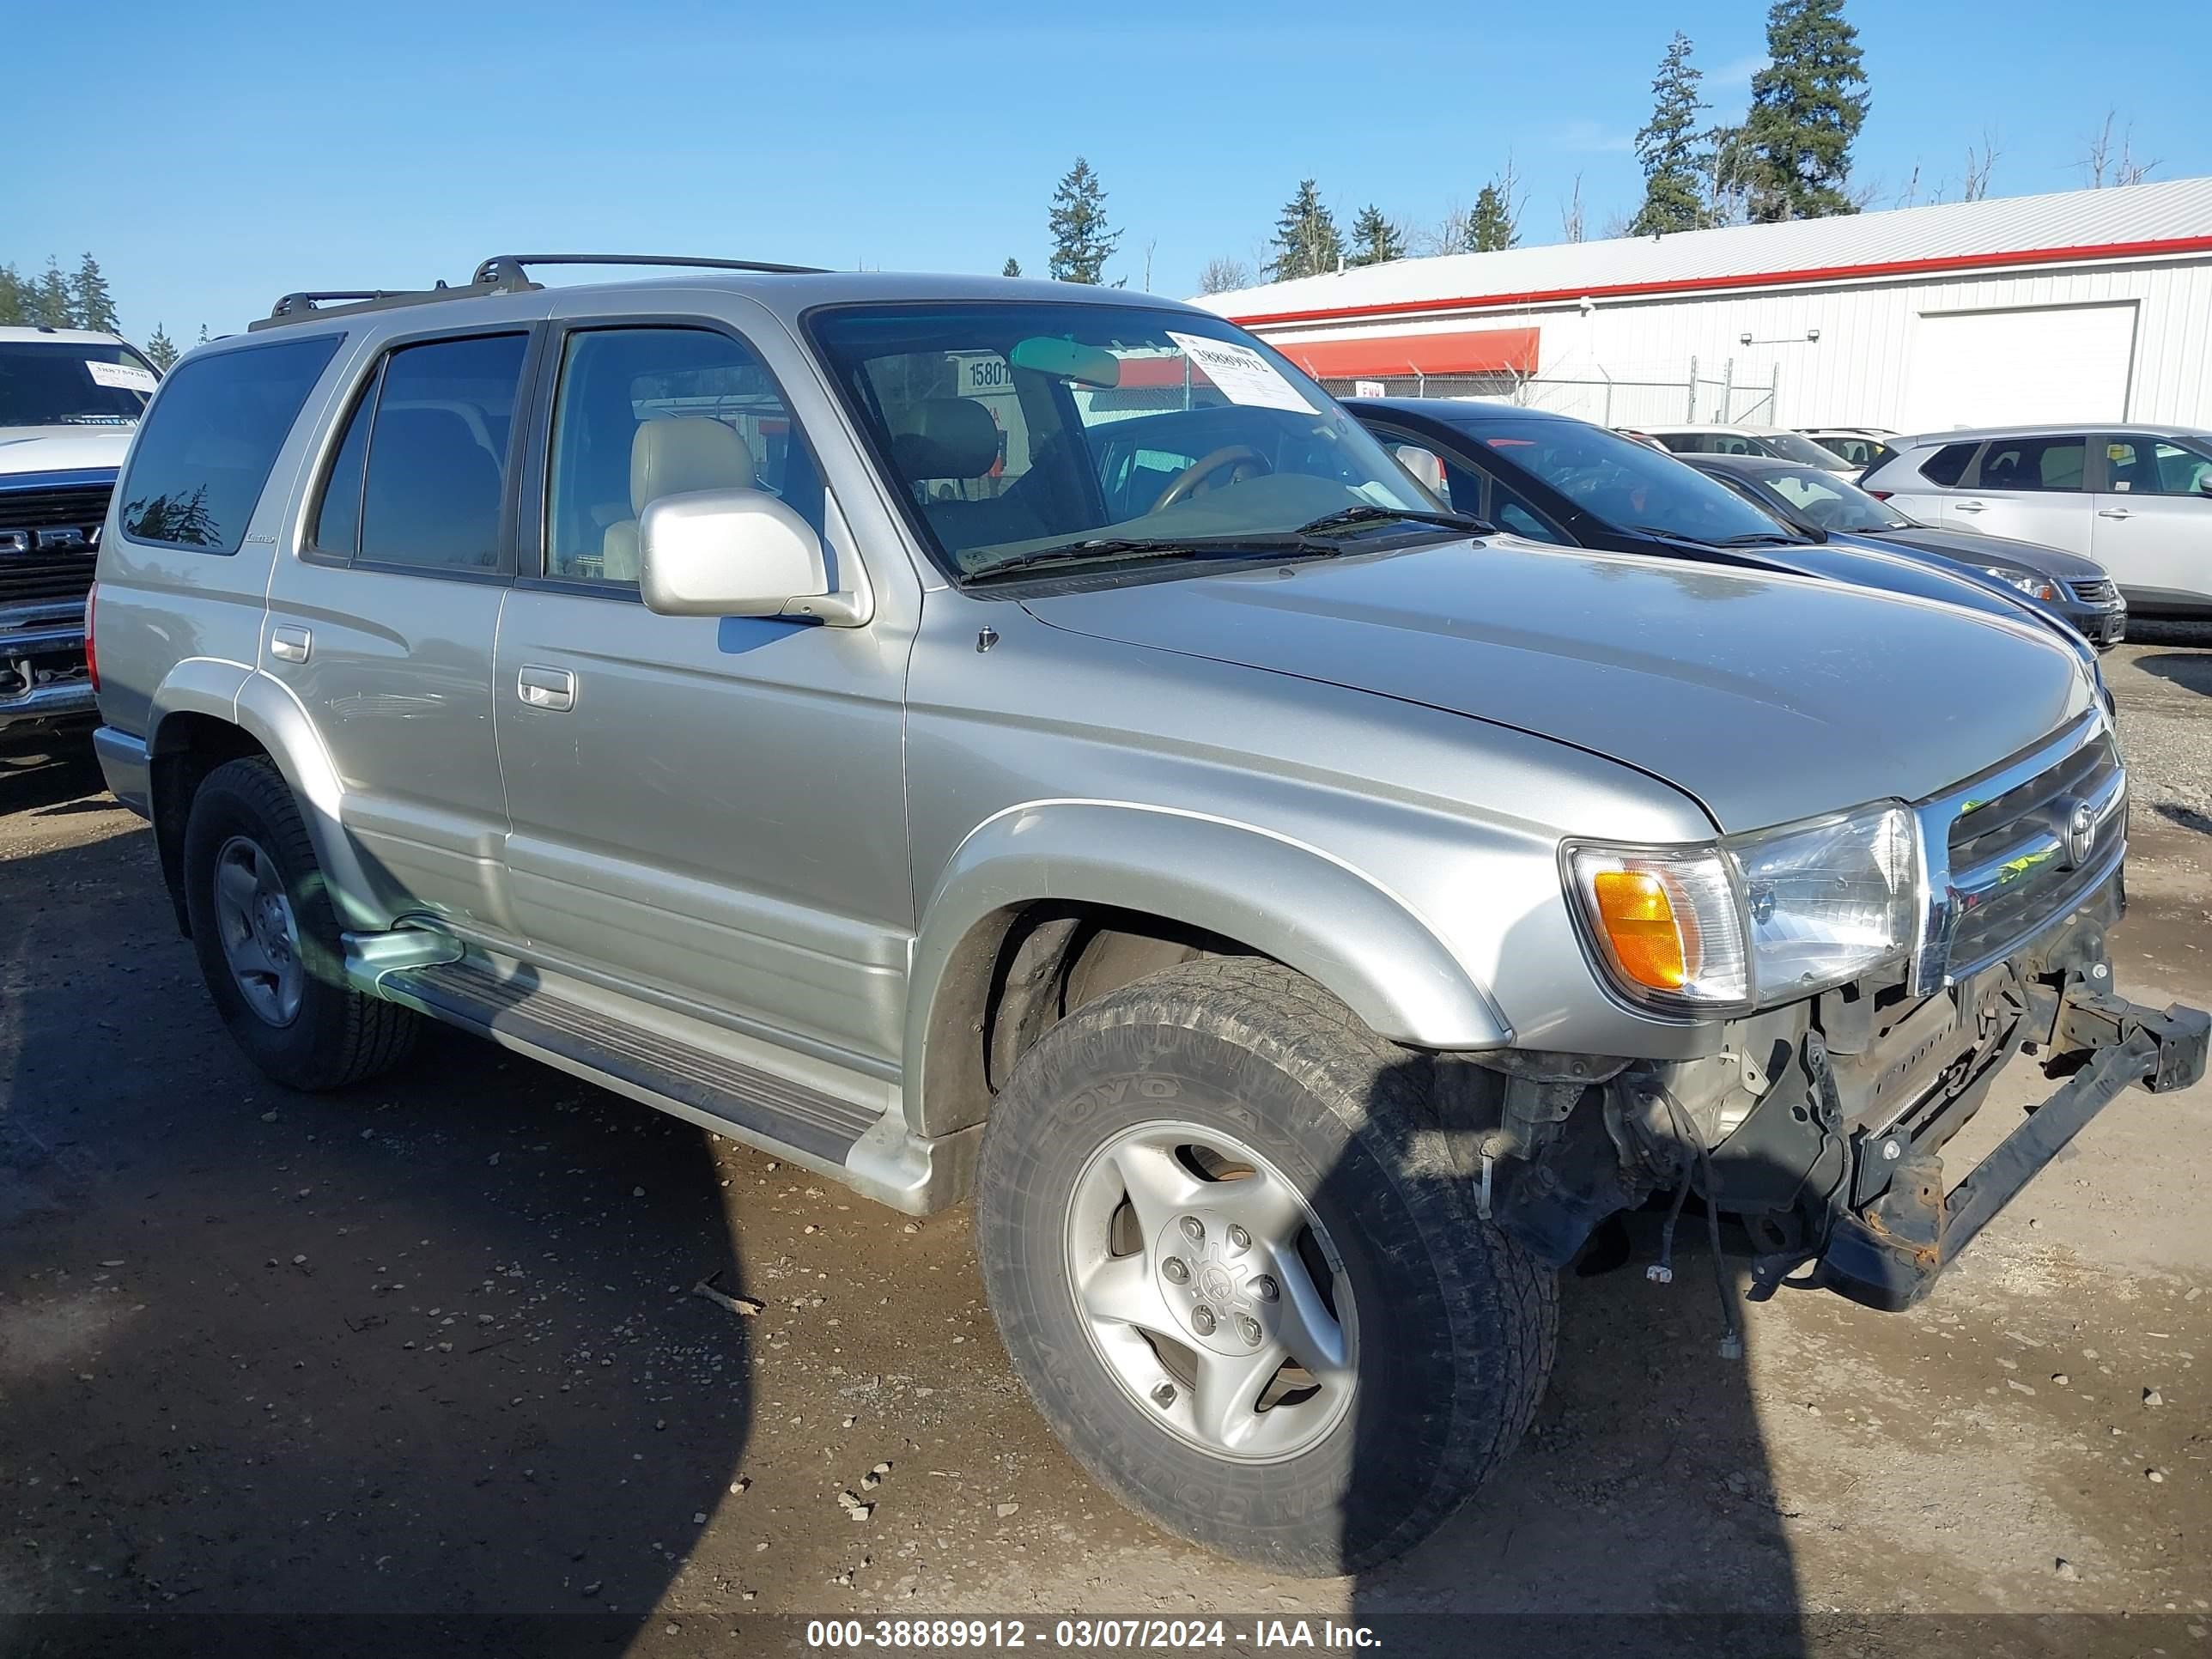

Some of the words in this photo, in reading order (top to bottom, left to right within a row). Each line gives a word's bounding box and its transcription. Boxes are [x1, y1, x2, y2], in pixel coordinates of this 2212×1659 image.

[1192, 349, 1269, 373] 38889912
[969, 362, 1012, 386] 15801
[1036, 1077, 1182, 1151] TOYO
